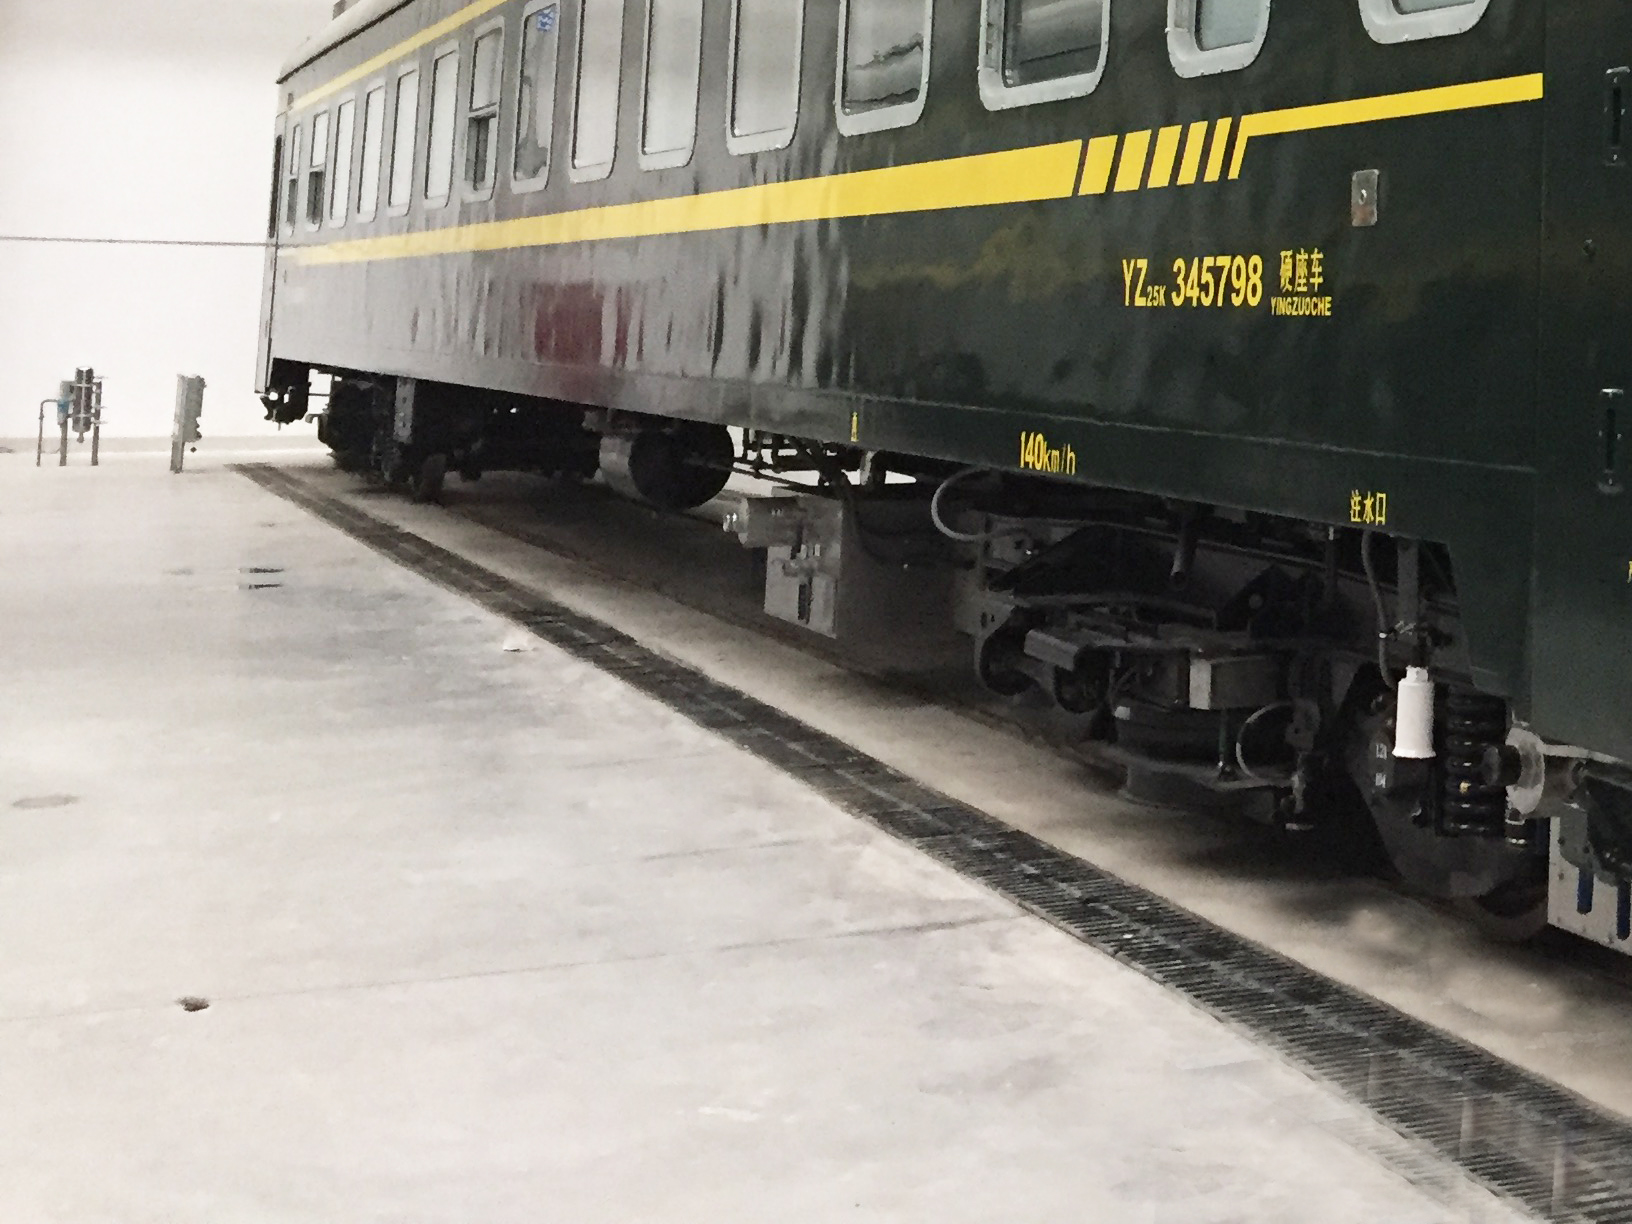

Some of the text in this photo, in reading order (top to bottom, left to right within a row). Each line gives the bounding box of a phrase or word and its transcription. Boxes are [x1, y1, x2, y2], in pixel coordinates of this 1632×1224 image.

[1170, 254, 1264, 308] 345798
[1279, 247, 1325, 294] 硬座车
[1270, 295, 1333, 317] YINGZUOCHE
[1019, 431, 1077, 475] 140km/h
[1350, 489, 1387, 527] 注水口
